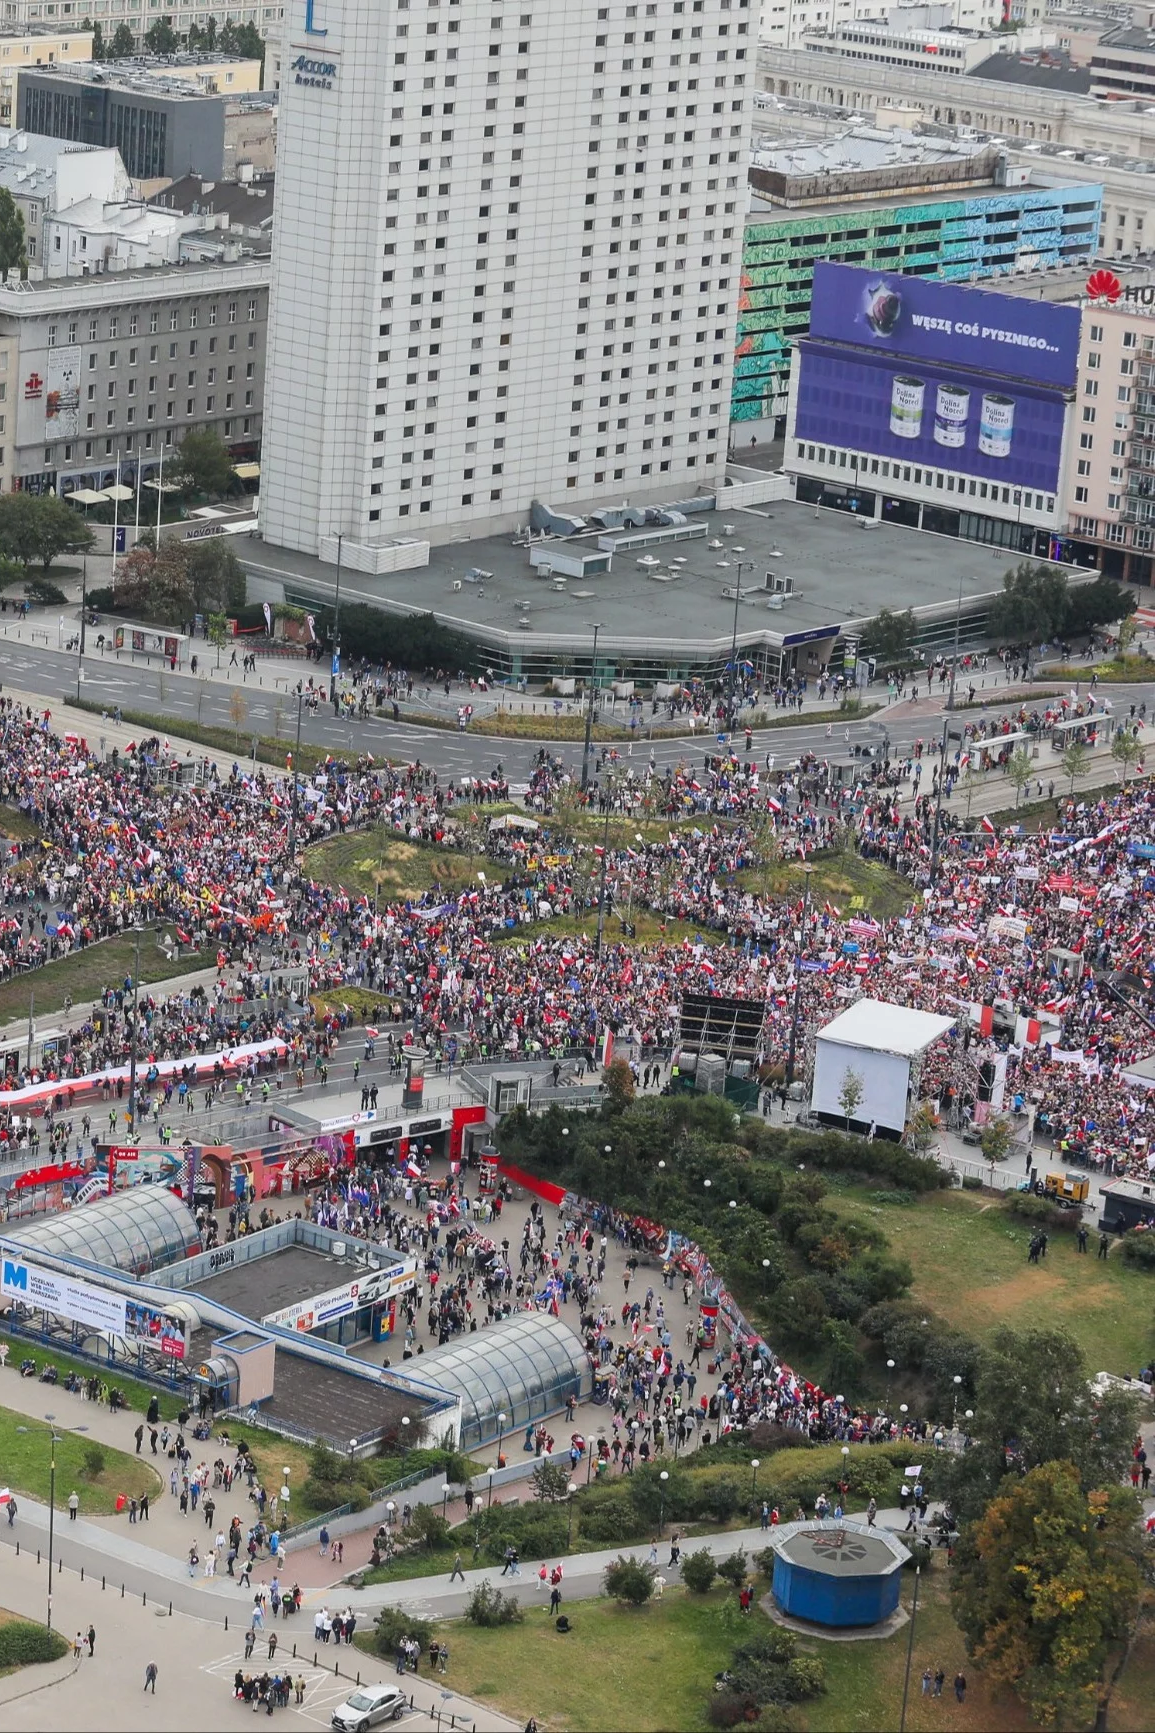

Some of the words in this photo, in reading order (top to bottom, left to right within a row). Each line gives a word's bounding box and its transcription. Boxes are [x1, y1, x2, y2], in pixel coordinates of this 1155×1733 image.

[291, 55, 337, 77] ACCOR
[295, 73, 332, 90] hotels
[1125, 285, 1155, 305] HU
[912, 314, 952, 335] WĘSZĘ
[954, 322, 979, 337] COŚ
[981, 327, 1060, 352] PYSZNEGO...
[896, 387, 916, 399] Dolina
[899, 395, 919, 406] Noteci
[940, 396, 960, 408] Dolina
[943, 404, 964, 415] Noteci
[985, 406, 1005, 417] Dolina
[988, 413, 1009, 424] Noteci
[30, 1276, 55, 1288] UCZELNIA
[30, 1289, 59, 1302] WARSZAWA
